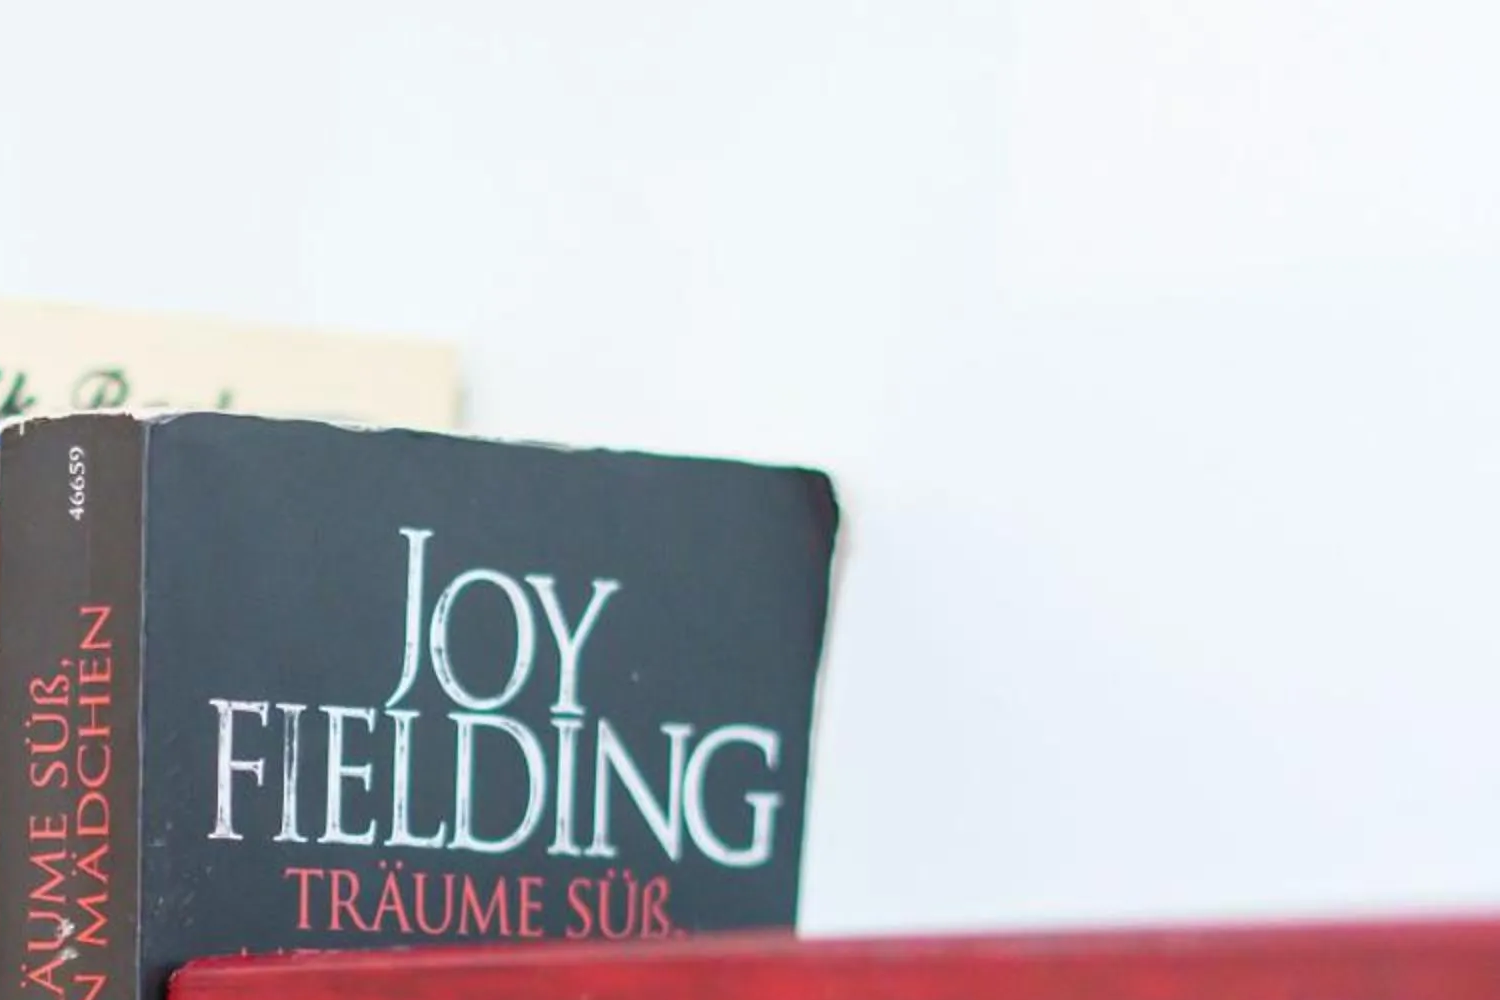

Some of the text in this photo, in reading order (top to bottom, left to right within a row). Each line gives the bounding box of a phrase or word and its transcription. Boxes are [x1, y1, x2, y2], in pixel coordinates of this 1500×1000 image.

[66, 445, 86, 521] 46659
[385, 527, 620, 715] JOY
[70, 603, 113, 947] MÄDCHEN
[207, 698, 783, 868] FIELDING
[284, 859, 544, 937] TRÄUME
